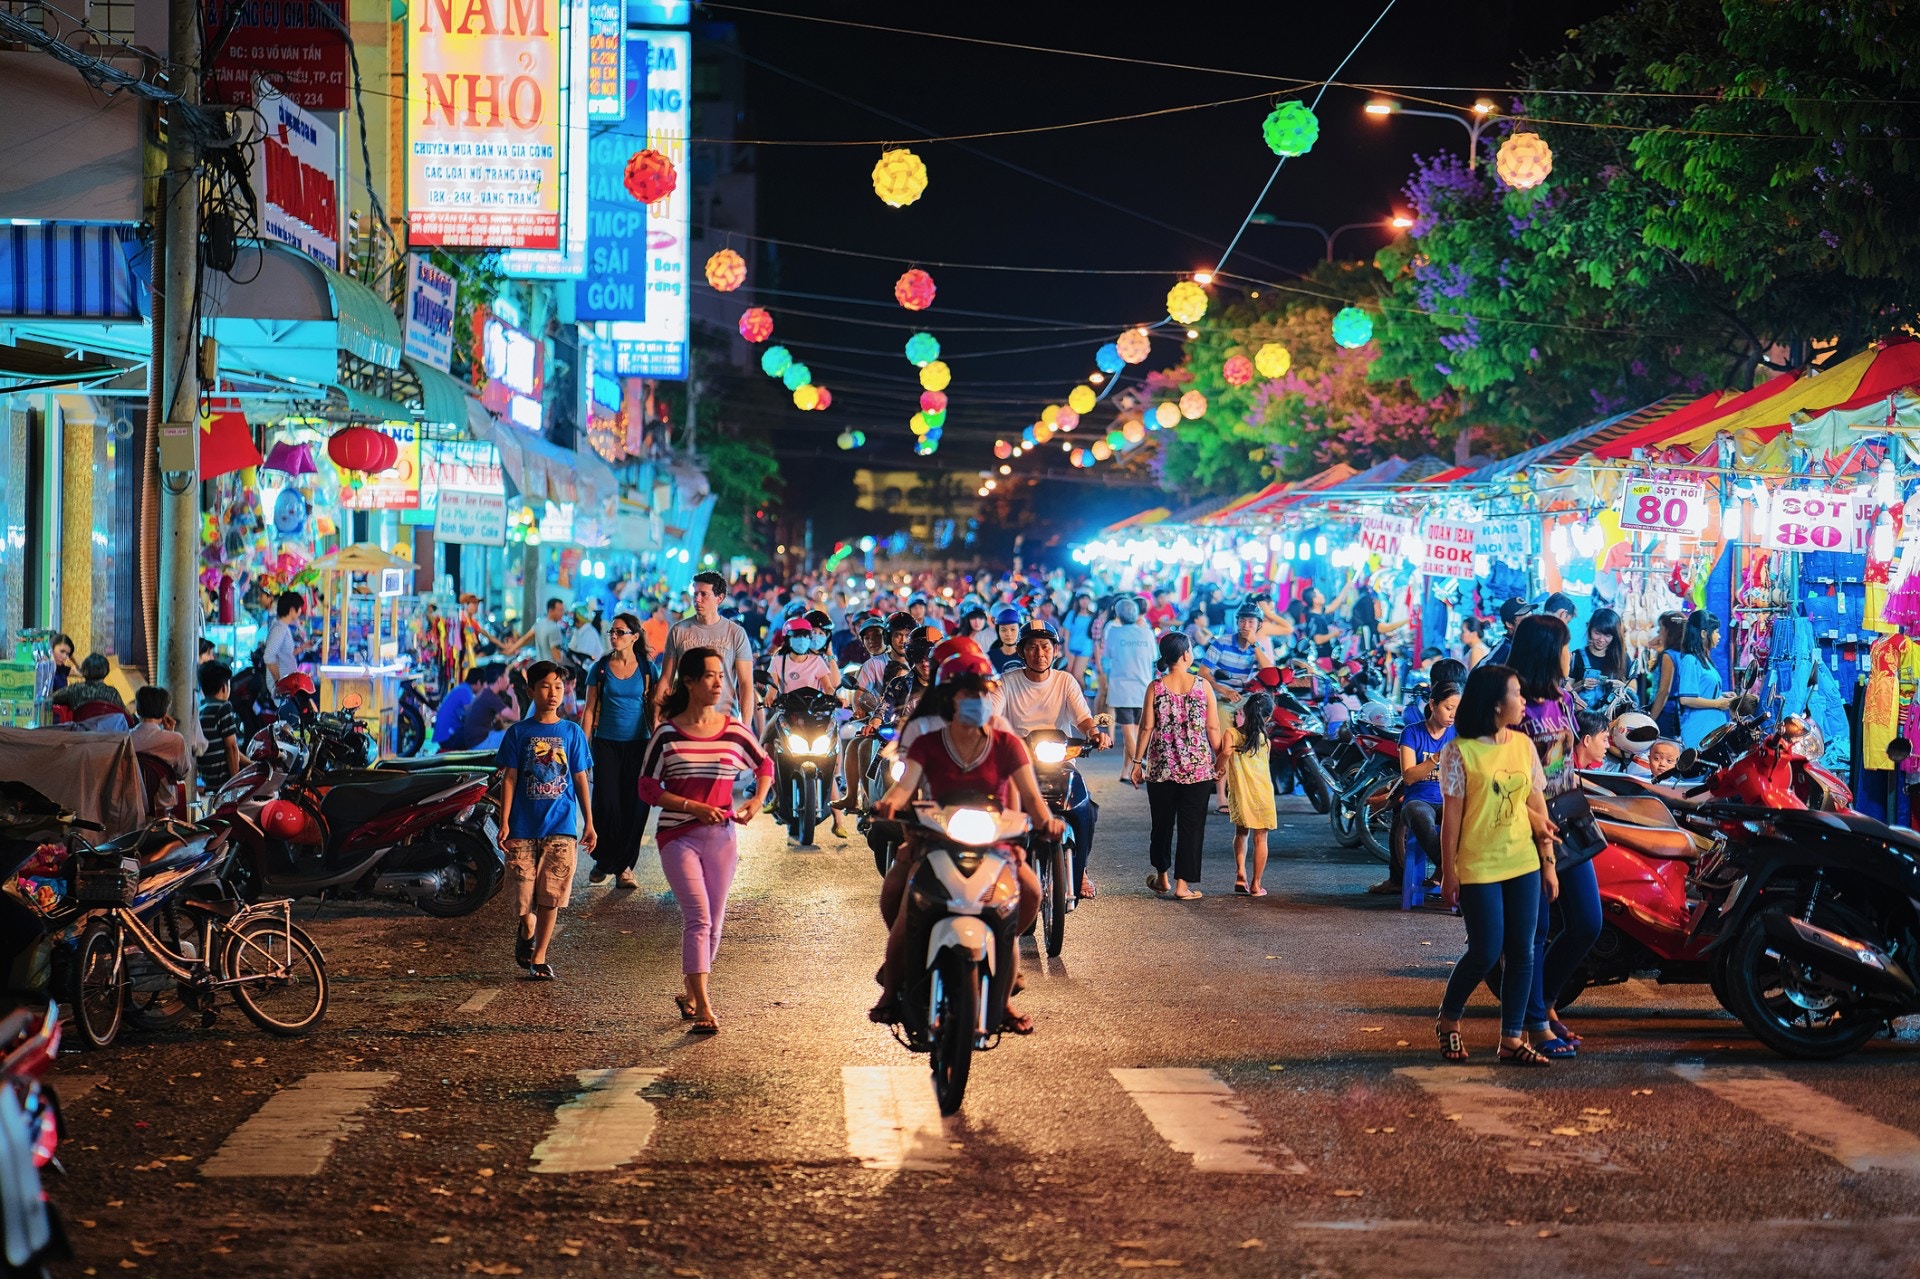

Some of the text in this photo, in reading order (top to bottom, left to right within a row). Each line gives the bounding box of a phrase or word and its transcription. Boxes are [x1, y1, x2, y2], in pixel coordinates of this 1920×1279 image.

[283, 1, 305, 29] GIA
[251, 47, 265, 60] 03
[304, 93, 323, 105] 234
[422, 52, 542, 129] NHỎ
[454, 143, 472, 156] MUA
[511, 145, 526, 158] GIA
[486, 168, 515, 181] TRANG
[454, 192, 472, 203] 24K
[588, 279, 634, 311] GÒN
[1636, 496, 1688, 528] 80
[1776, 522, 1842, 548] 80
